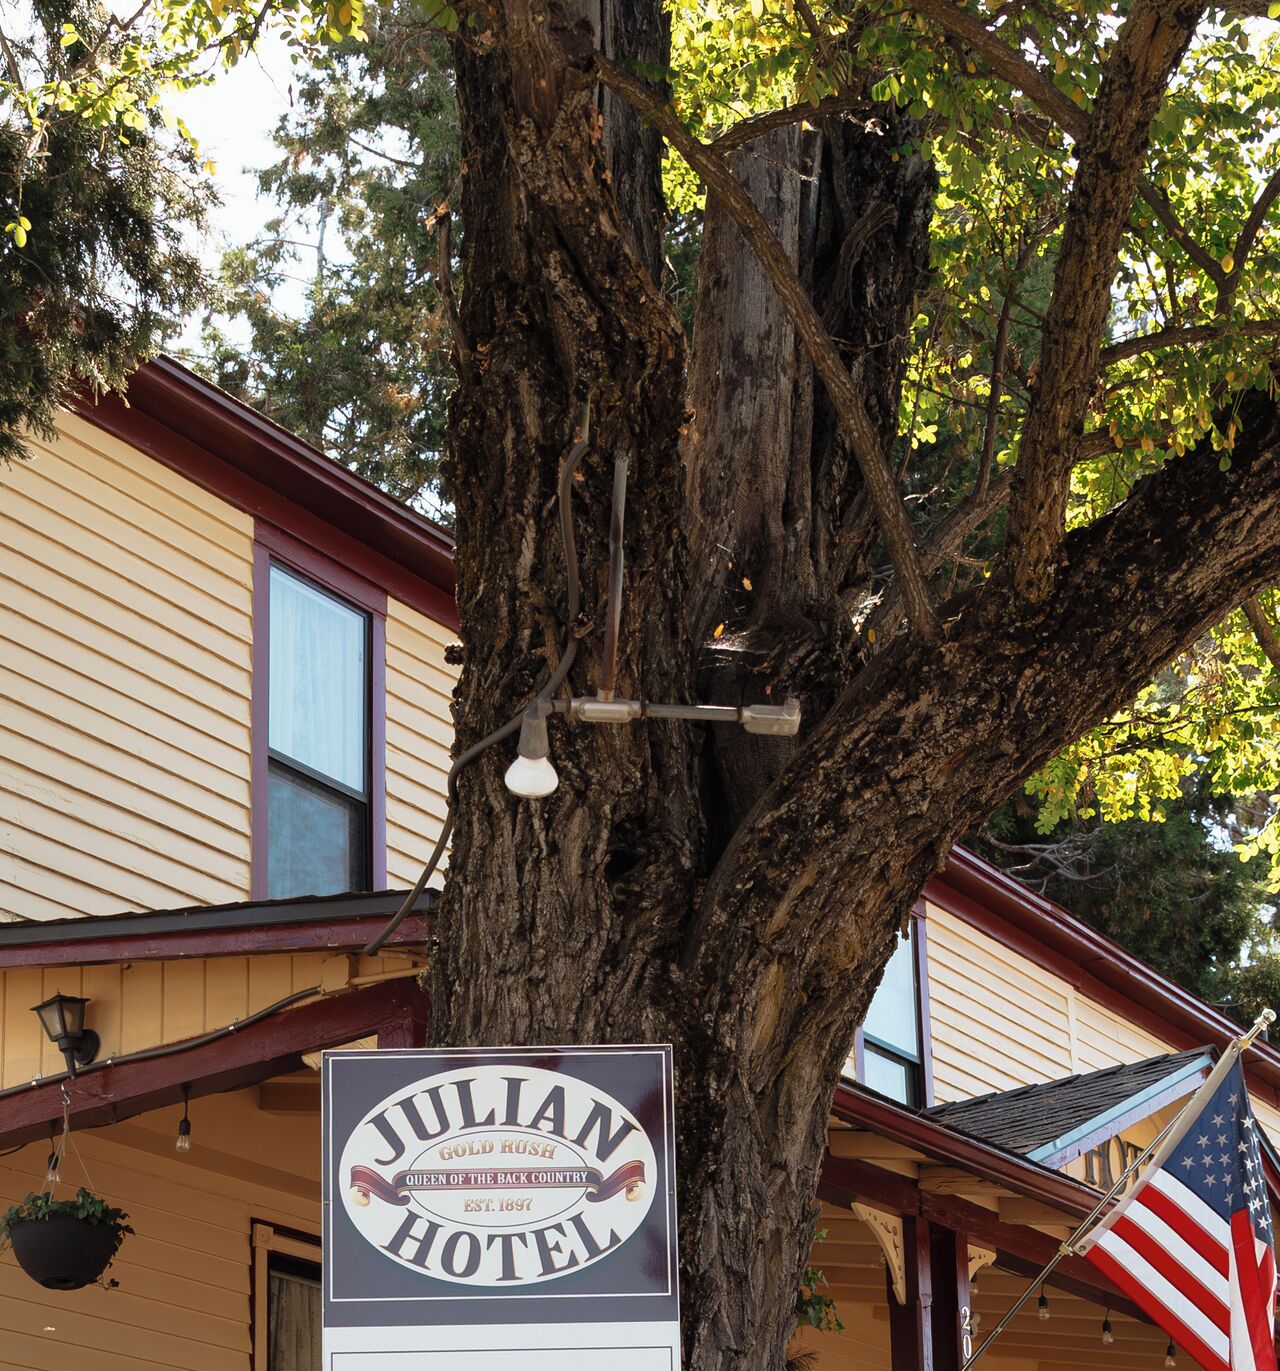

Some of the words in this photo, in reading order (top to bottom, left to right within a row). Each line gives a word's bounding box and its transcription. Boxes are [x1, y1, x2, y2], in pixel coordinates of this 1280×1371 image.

[364, 1077, 642, 1166] JULIAN
[438, 1139, 494, 1161] GOLD
[499, 1138, 558, 1160] RUSH
[1085, 1135, 1154, 1195] HOT
[406, 1173, 446, 1186] QUEEN
[450, 1173, 465, 1185] OF
[469, 1173, 494, 1185] THE
[497, 1172, 527, 1184] BACK
[531, 1171, 588, 1184] COUNTRY
[463, 1198, 495, 1213] EST.
[499, 1197, 533, 1212] 1897
[379, 1207, 622, 1282] HOTEL
